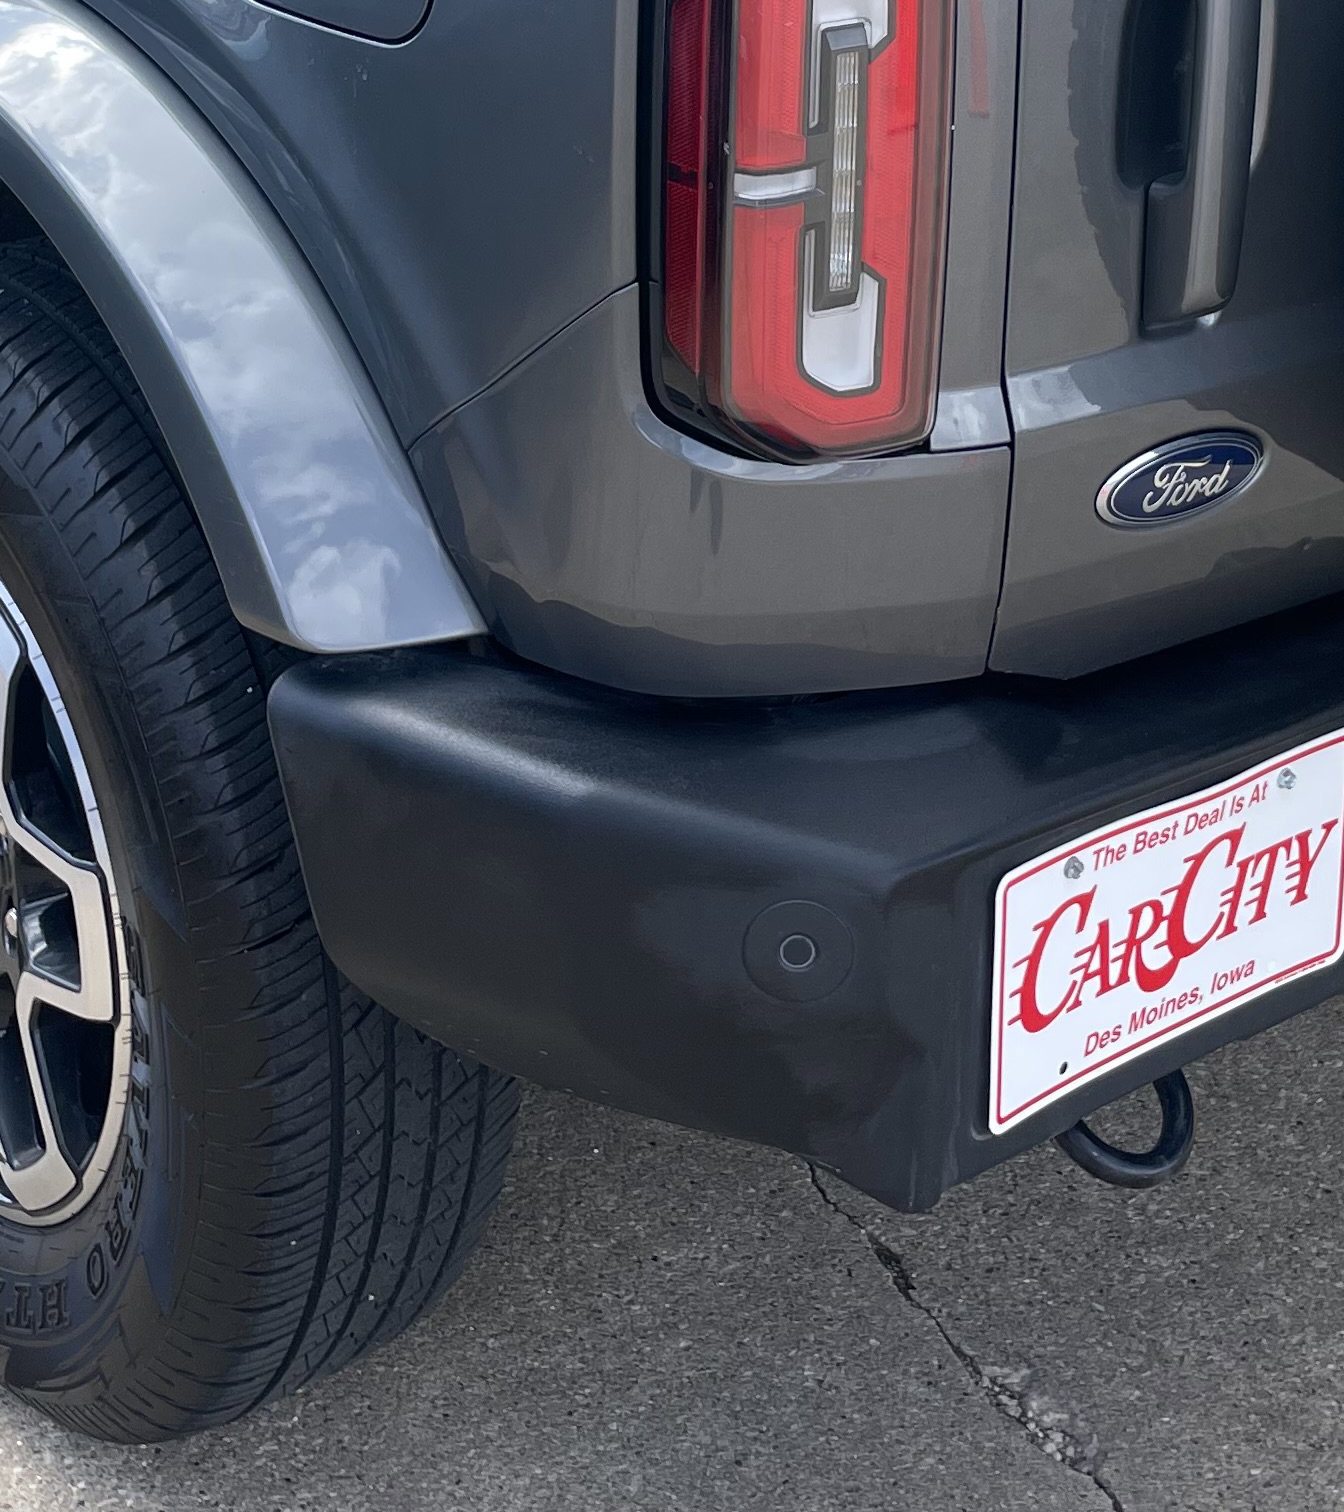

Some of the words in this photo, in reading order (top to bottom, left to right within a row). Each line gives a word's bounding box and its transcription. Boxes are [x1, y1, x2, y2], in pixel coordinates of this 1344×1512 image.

[1142, 454, 1233, 513] Ford
[1092, 840, 1128, 872] The
[1133, 820, 1180, 857] Best
[1183, 799, 1226, 836] Deal
[1229, 794, 1244, 817] Is
[1247, 782, 1269, 809] At
[1083, 1021, 1122, 1058] Des
[1127, 984, 1205, 1037] Moines,
[1209, 958, 1256, 996] Iowa
